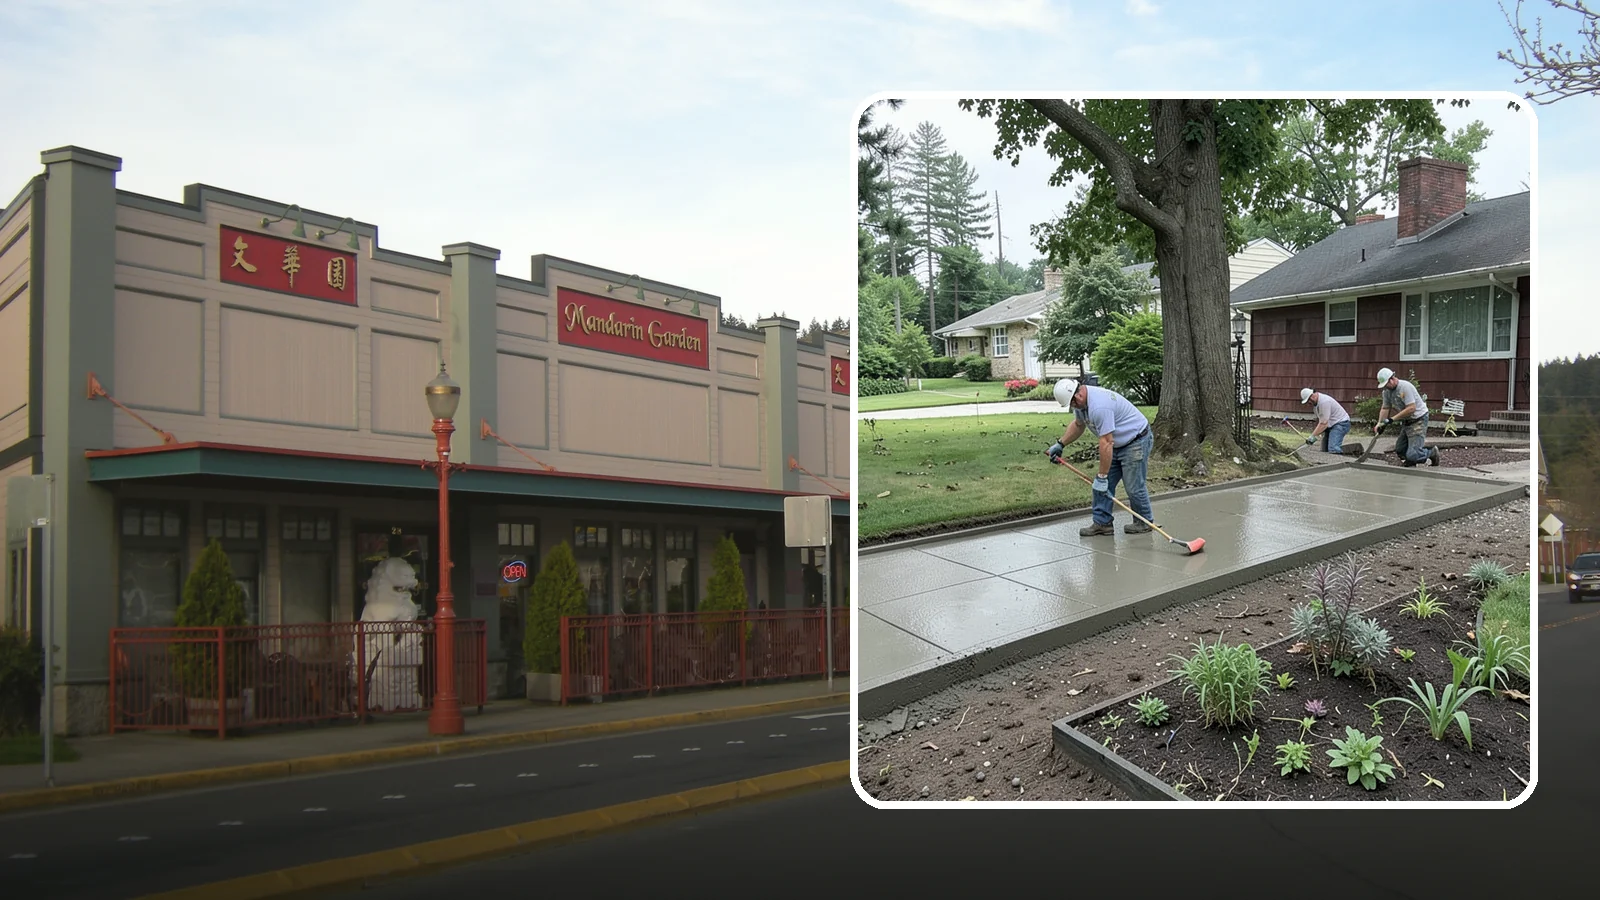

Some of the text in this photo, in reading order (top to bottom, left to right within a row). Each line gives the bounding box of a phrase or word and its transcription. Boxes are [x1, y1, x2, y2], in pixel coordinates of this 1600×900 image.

[231, 235, 346, 291] 文華園
[564, 302, 701, 352] Mandarin Garden
[503, 565, 527, 578] OPEN
